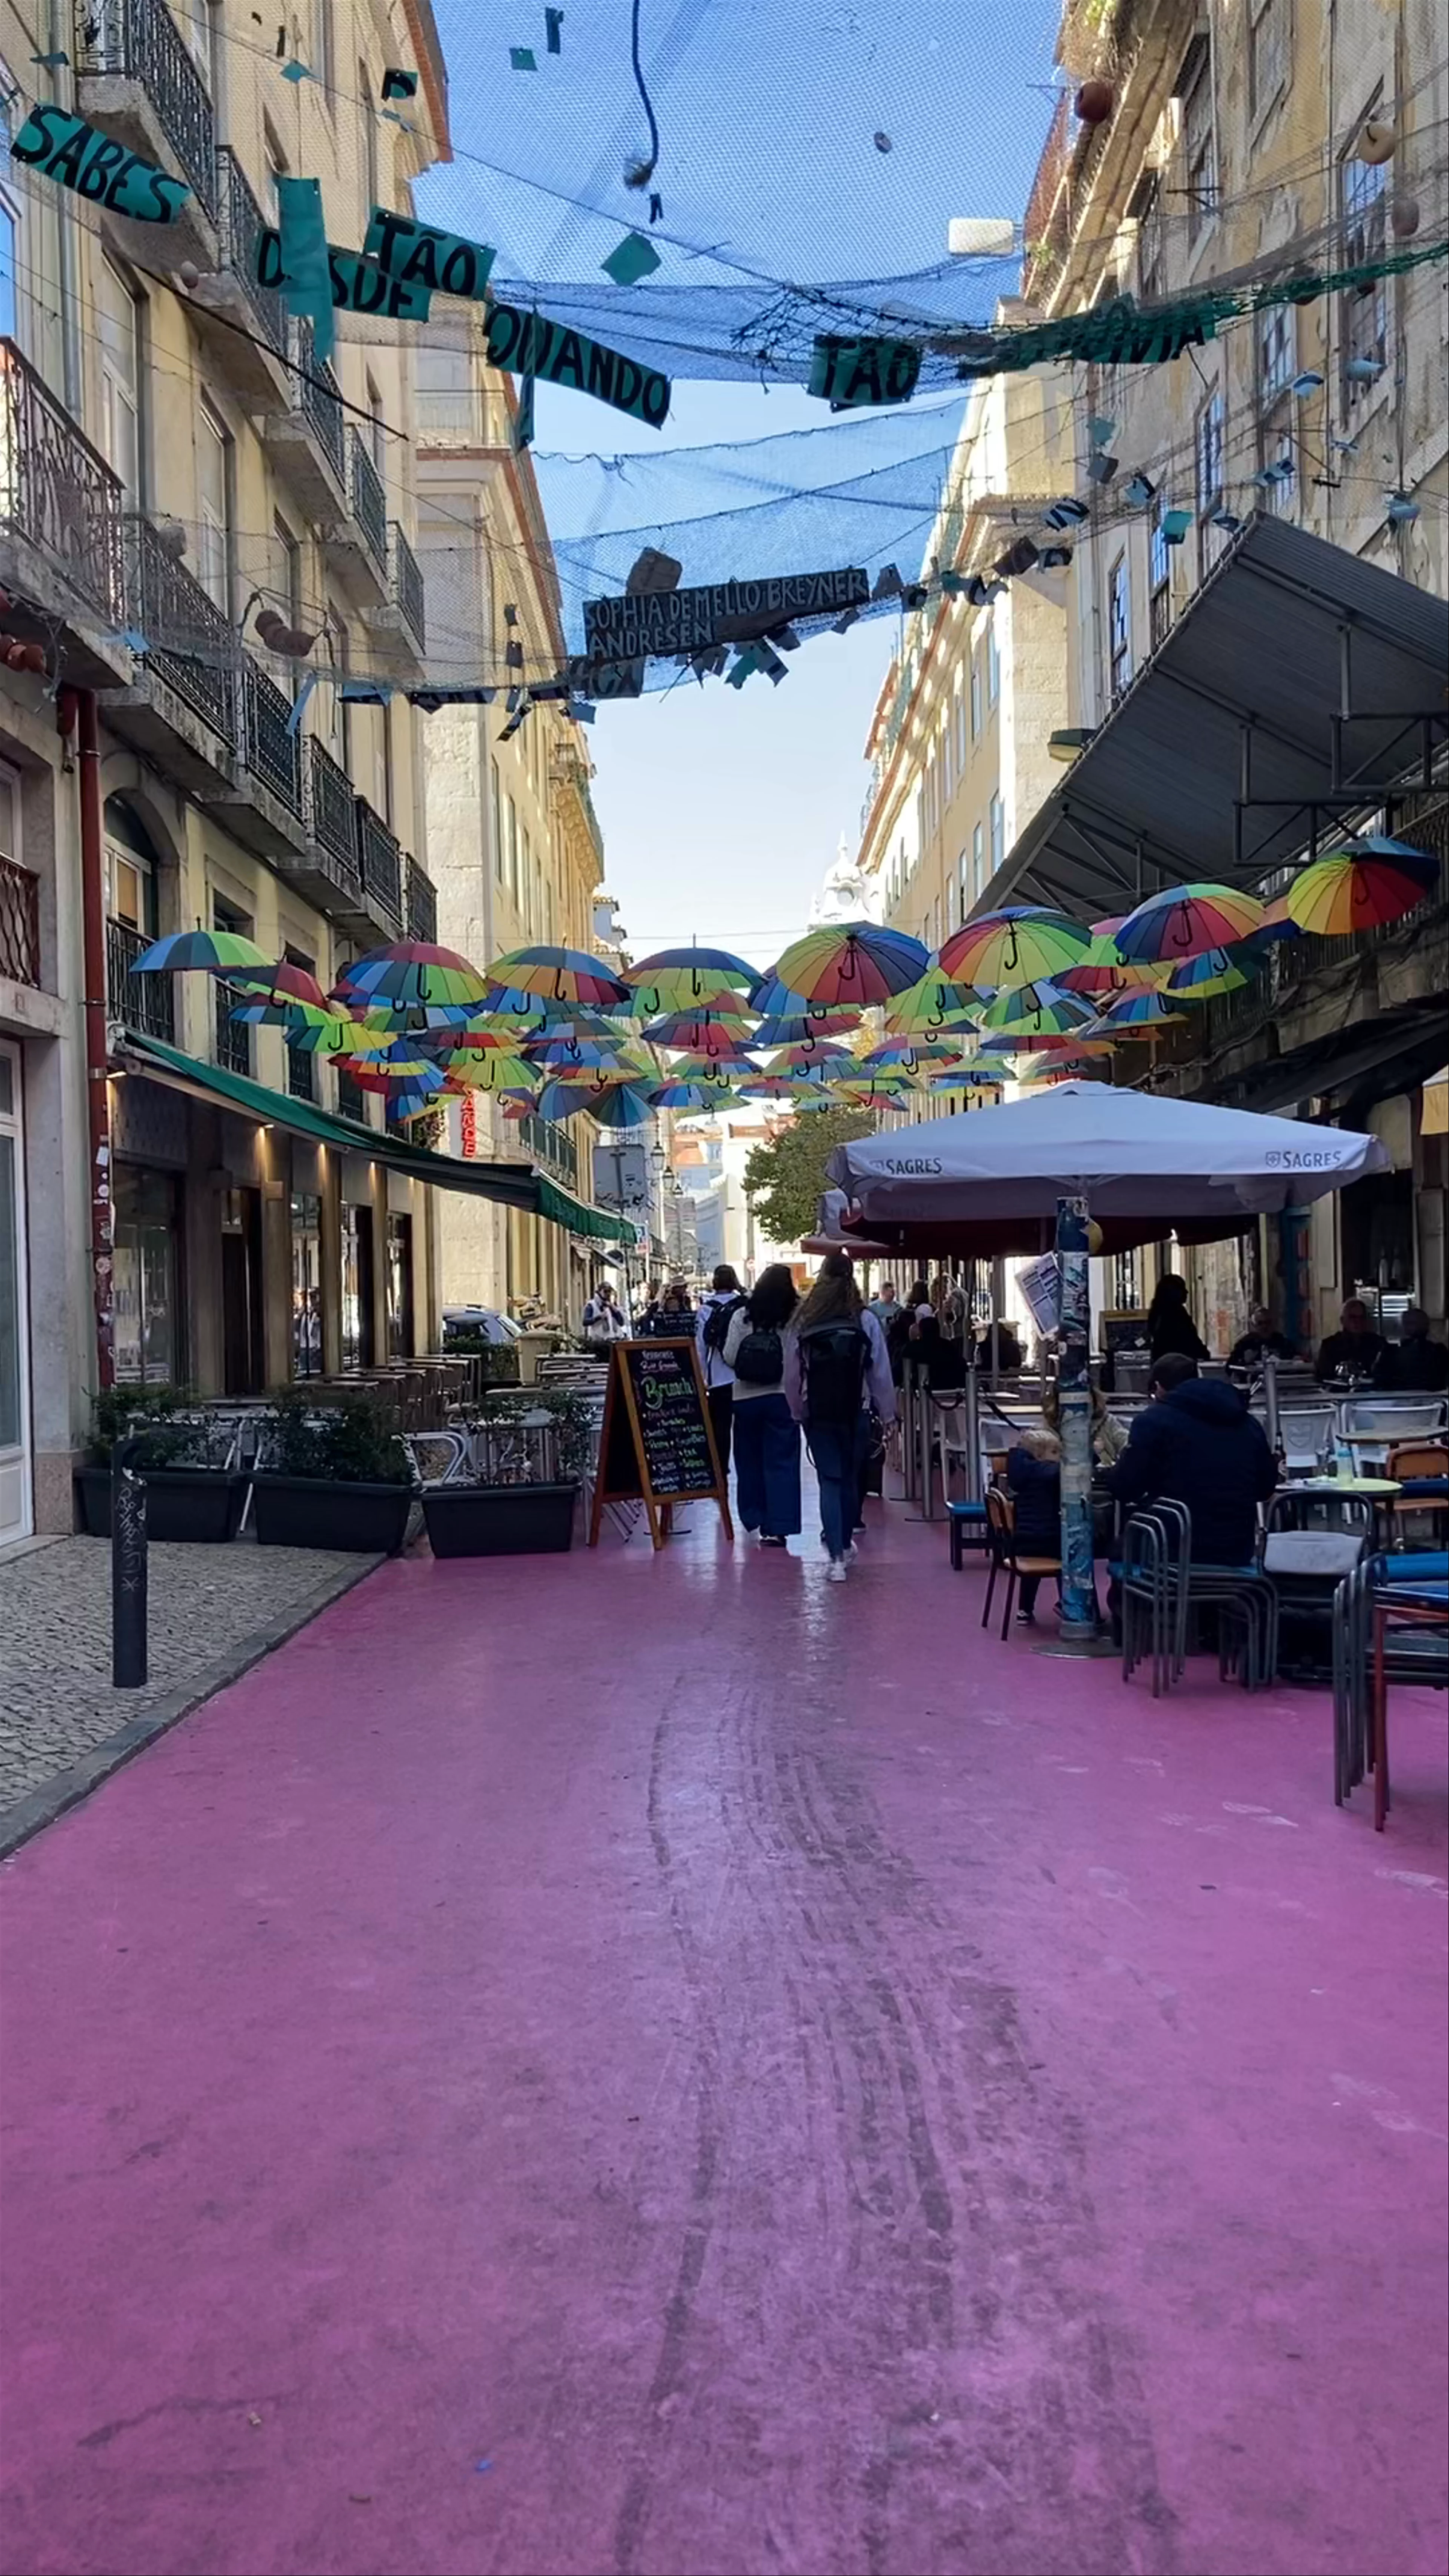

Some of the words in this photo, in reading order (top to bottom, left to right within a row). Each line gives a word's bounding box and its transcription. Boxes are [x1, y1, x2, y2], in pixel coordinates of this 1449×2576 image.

[10, 105, 186, 224] SABES
[375, 211, 477, 296] TÃO
[483, 302, 671, 429] QUANDO
[586, 596, 665, 630] SOPHIA
[670, 590, 692, 621] DE
[695, 583, 759, 618] MELLO
[767, 571, 868, 610] BREYNER
[589, 620, 713, 659] ANDRESEN
[886, 1157, 943, 1175] SAGRES
[1282, 1150, 1343, 1169] SAGRES
[640, 1375, 694, 1410] Brunch
